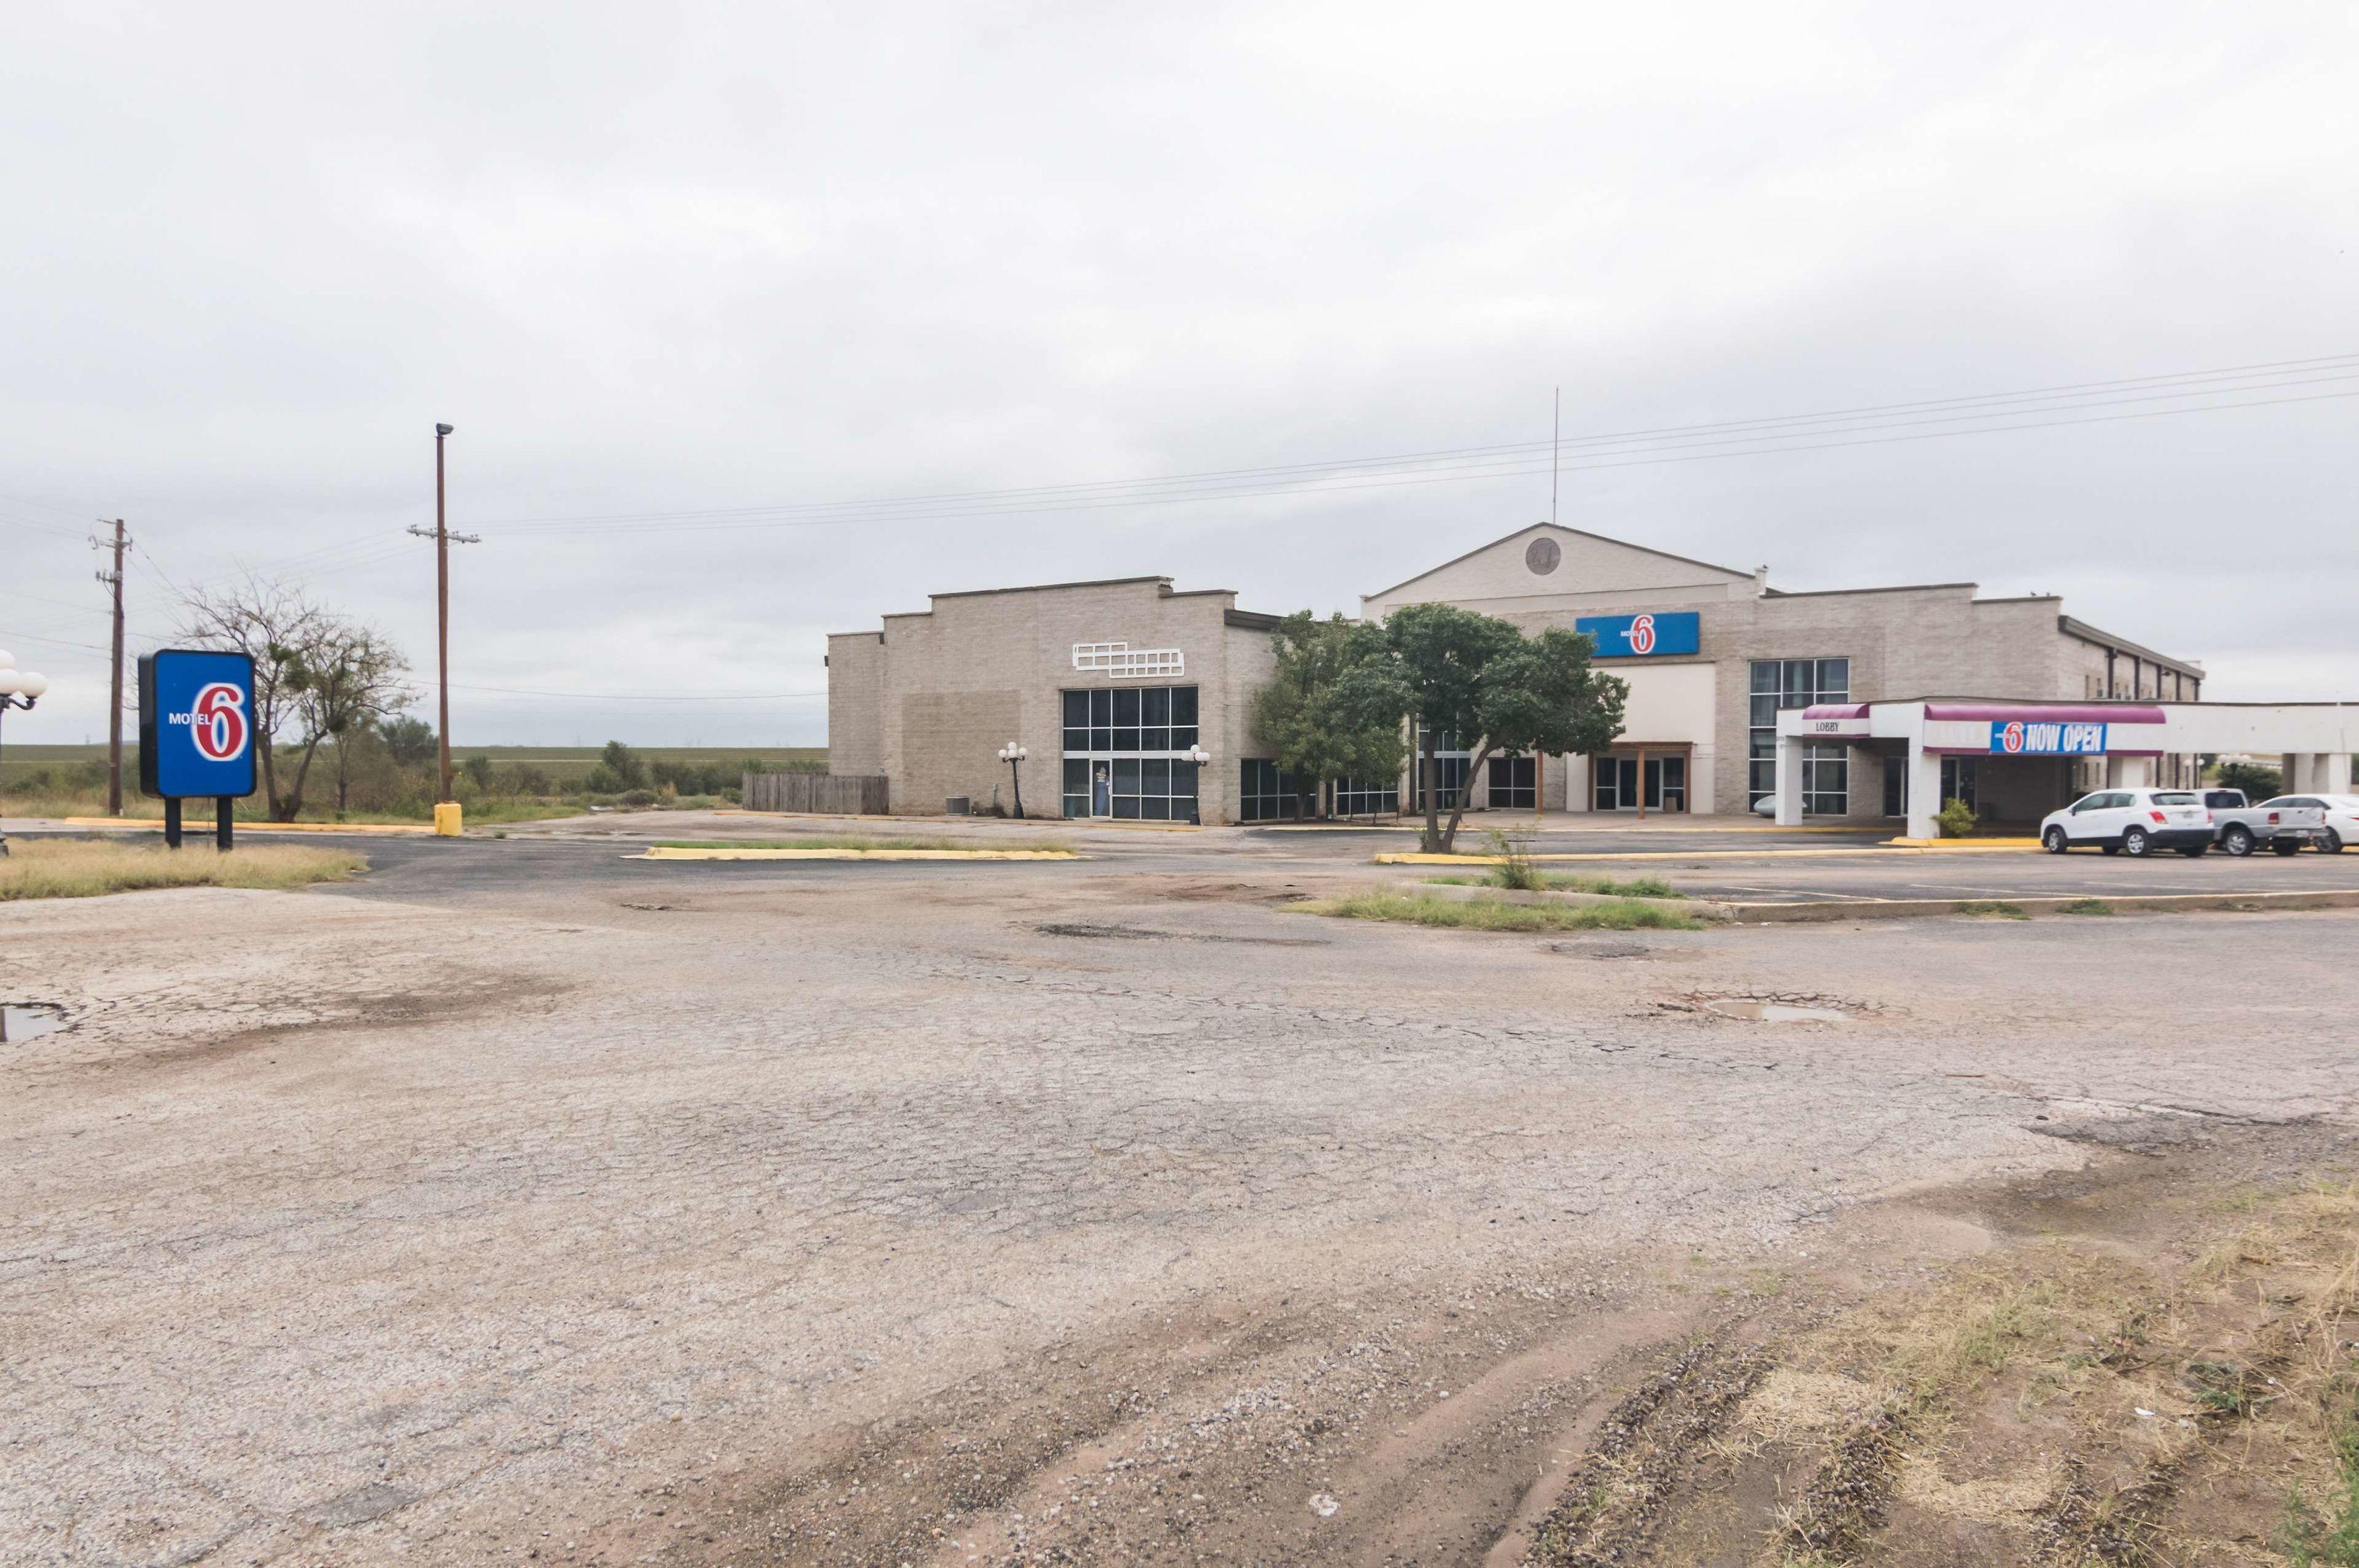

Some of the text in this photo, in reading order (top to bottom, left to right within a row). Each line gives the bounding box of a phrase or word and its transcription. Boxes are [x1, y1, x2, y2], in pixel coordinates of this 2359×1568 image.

[1630, 615, 1655, 654] 6
[168, 682, 248, 761] MOTEL 6
[1816, 722, 1840, 732] LOBBY
[2002, 722, 2103, 753] 6 NOW OPEN
